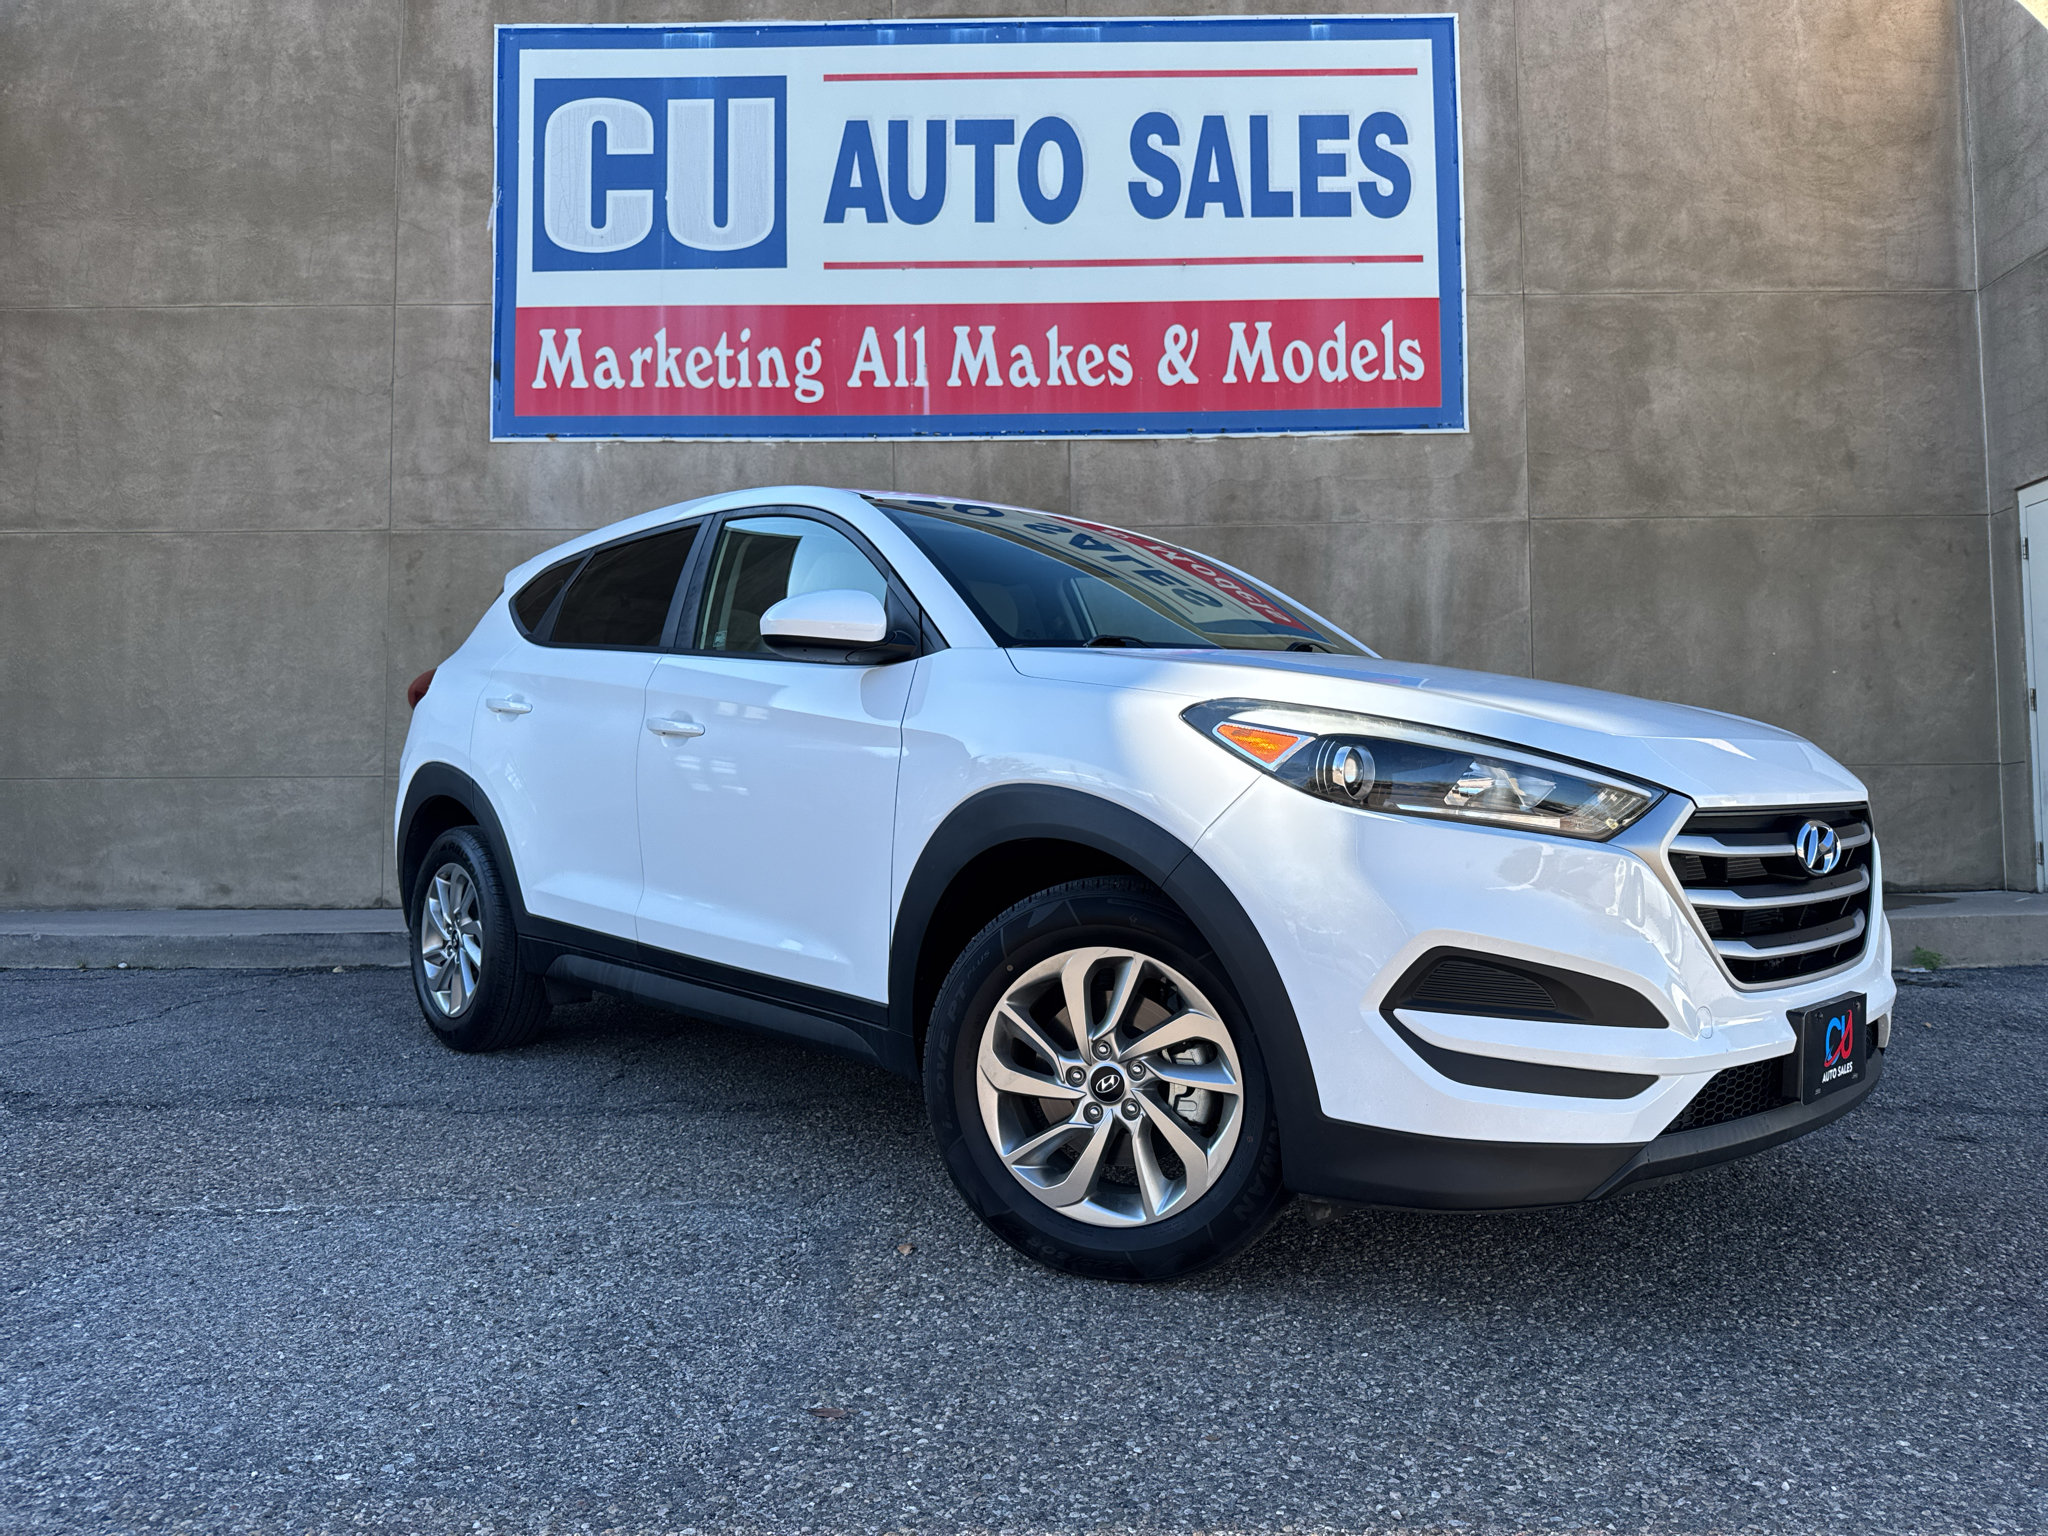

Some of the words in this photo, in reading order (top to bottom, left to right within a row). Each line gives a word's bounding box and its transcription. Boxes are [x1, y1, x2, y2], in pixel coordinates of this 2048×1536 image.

[544, 97, 776, 254] CU
[823, 115, 1085, 226] AUTO
[1127, 111, 1412, 220] SALES
[531, 327, 826, 404] Marketing
[847, 326, 929, 388] All
[946, 325, 1133, 388] Makes
[1157, 324, 1199, 386] &
[1222, 320, 1426, 384] Models
[1821, 1070, 1837, 1083] AUTO
[1837, 1061, 1853, 1077] SALES
